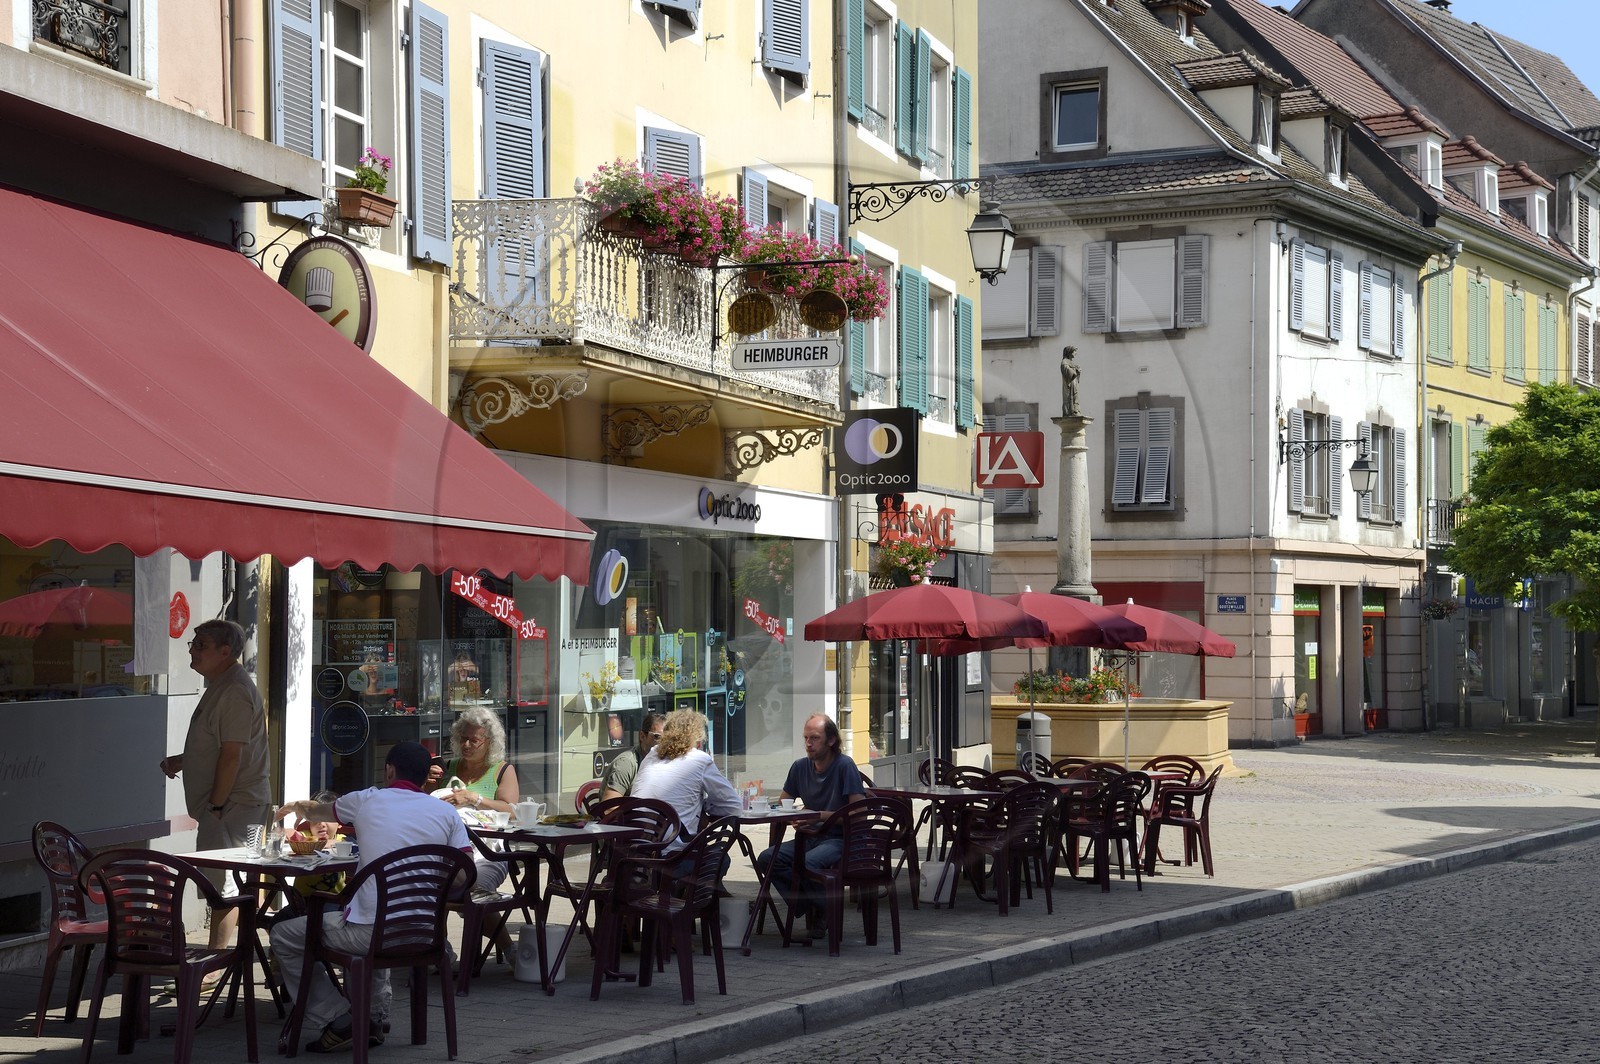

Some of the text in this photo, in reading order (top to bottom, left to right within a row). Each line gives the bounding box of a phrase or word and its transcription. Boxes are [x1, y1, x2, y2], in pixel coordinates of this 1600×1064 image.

[743, 346, 829, 364] HEIMBURGER
[839, 473, 911, 489] Optic 2000
[735, 497, 762, 523] 2000
[455, 575, 481, 598] -50%
[491, 596, 515, 619] -50%
[745, 600, 760, 618] -50%
[1470, 597, 1499, 605] MACIF
[329, 623, 393, 631] HORAIRES D'OUVERTURE
[520, 618, 536, 639] -50%
[765, 616, 780, 634] -50%
[561, 637, 617, 650] A et B HEIMBURGER
[0, 751, 47, 781] riotte
